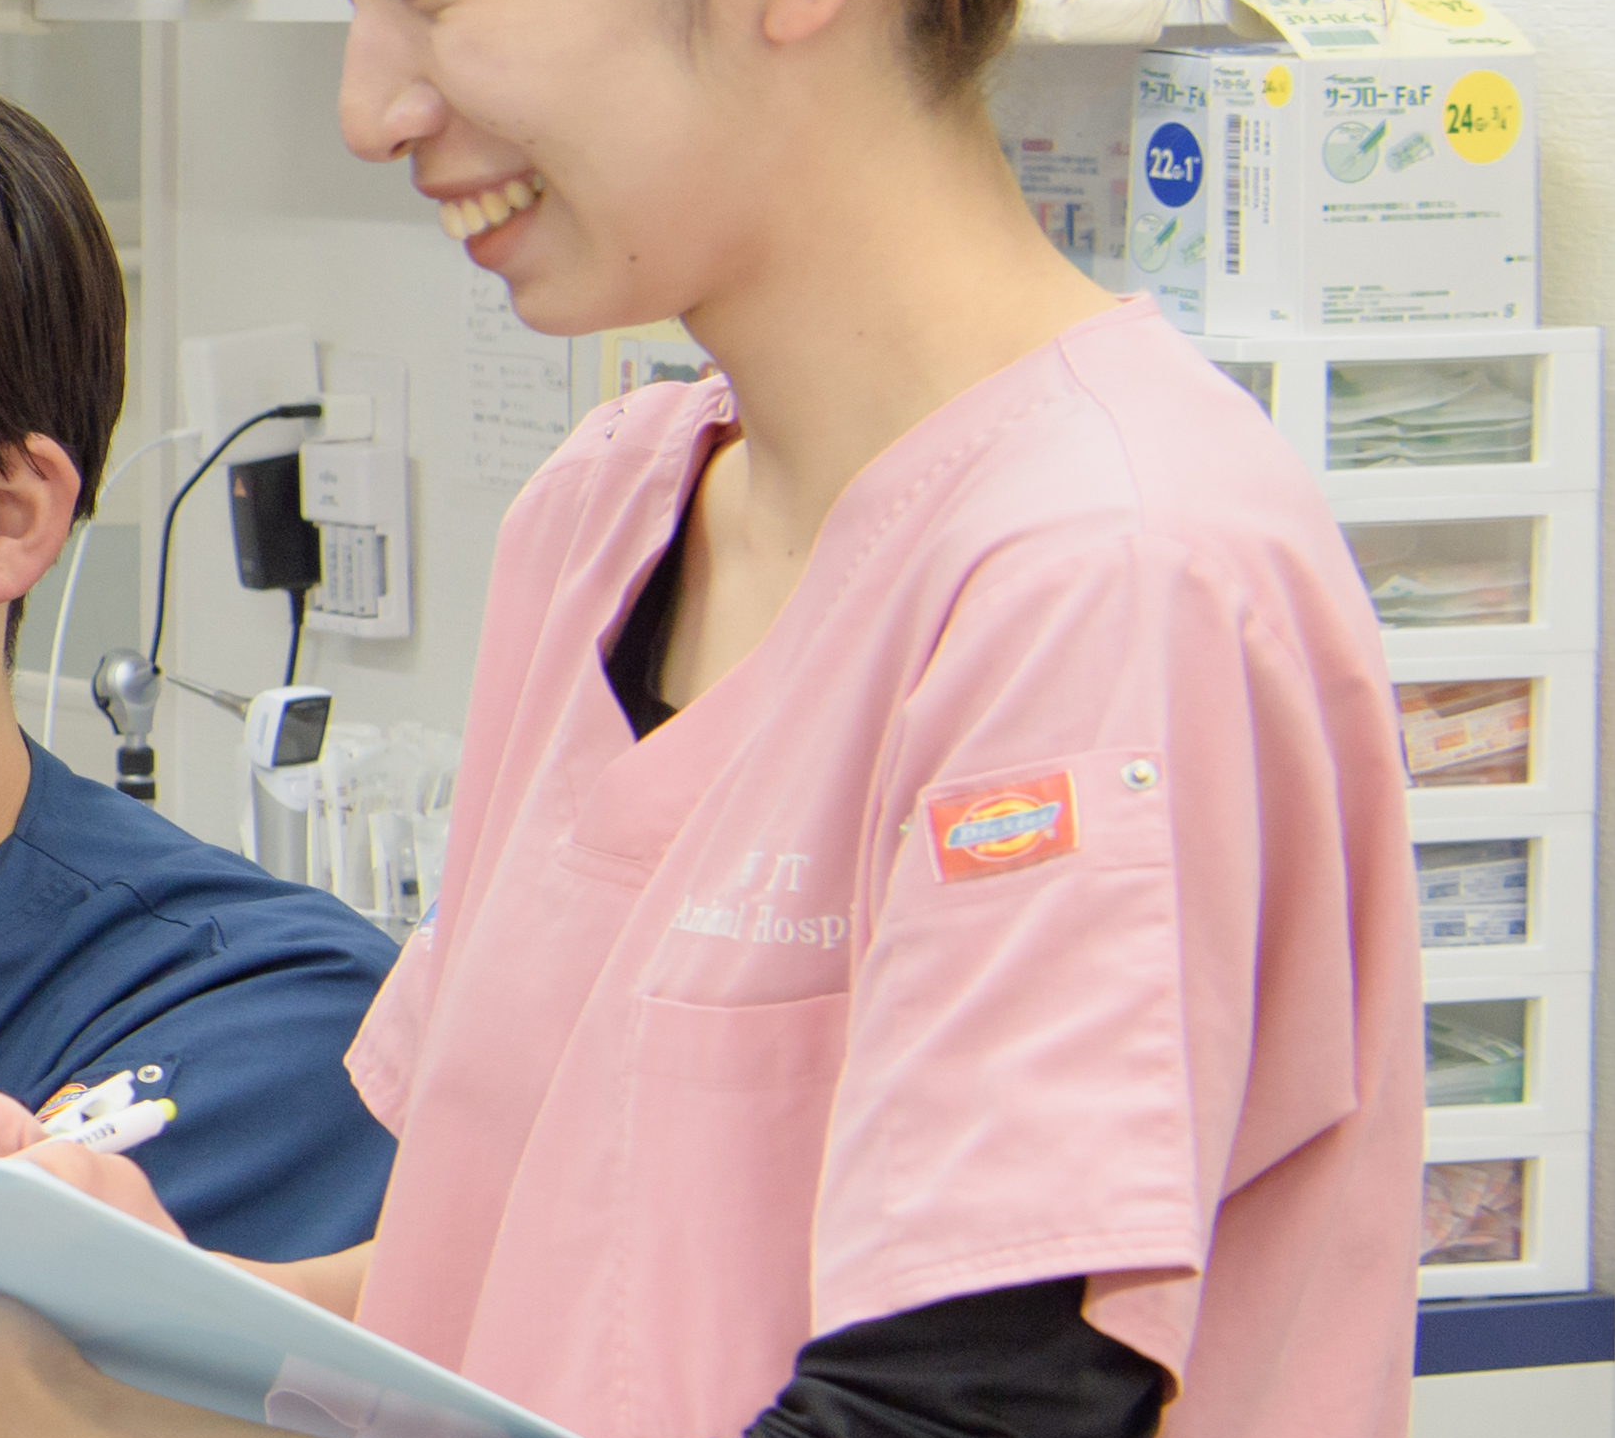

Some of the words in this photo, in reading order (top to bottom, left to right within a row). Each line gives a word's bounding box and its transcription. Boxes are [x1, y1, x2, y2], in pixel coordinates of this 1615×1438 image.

[1323, 86, 1389, 109] サーフロー
[1394, 84, 1434, 107] F&F
